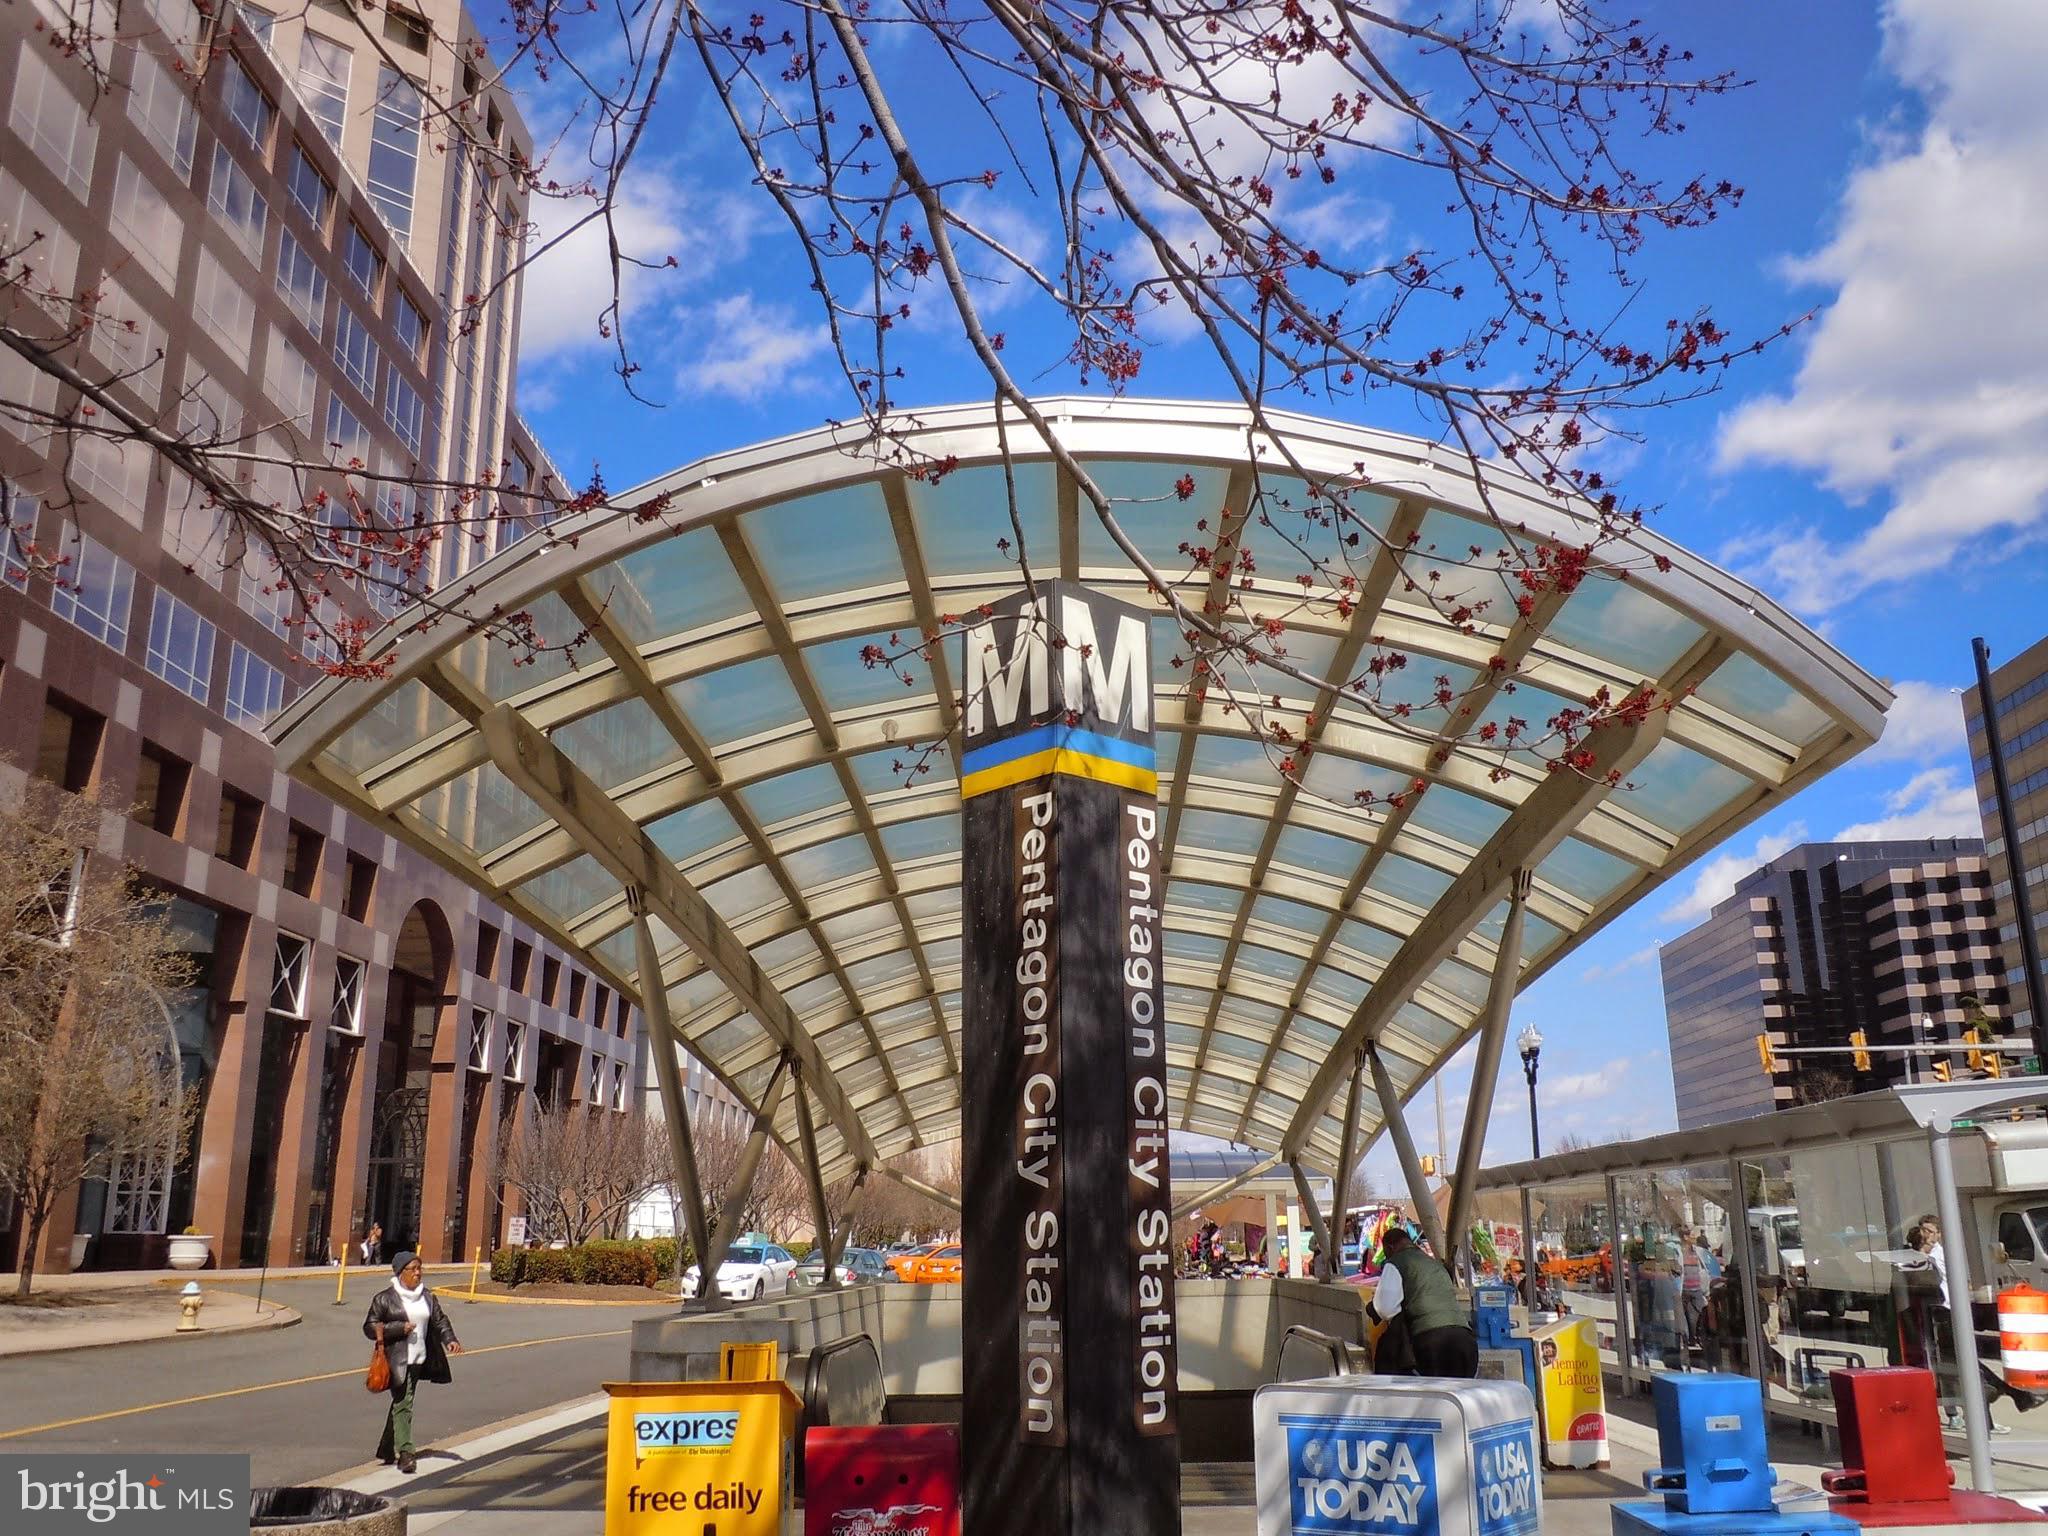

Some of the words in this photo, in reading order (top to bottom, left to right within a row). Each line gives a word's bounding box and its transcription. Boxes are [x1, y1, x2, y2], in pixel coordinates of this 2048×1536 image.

[967, 595, 1049, 738] M
[1062, 595, 1149, 734] M
[1016, 792, 1054, 1056] Pentagon
[1124, 804, 1159, 1058] Pentagon
[1018, 1073, 1057, 1188] City
[1129, 1076, 1165, 1188] City
[1025, 1210, 1061, 1433] Station
[1137, 1208, 1172, 1425] Station
[1558, 1372, 1598, 1386] Latino
[627, 1485, 687, 1513] free
[694, 1481, 763, 1515] daily
[1298, 1477, 1427, 1526] TODAY
[1337, 1439, 1421, 1483] USA
[1480, 1474, 1531, 1523] TODAY
[1494, 1440, 1528, 1480] USA
